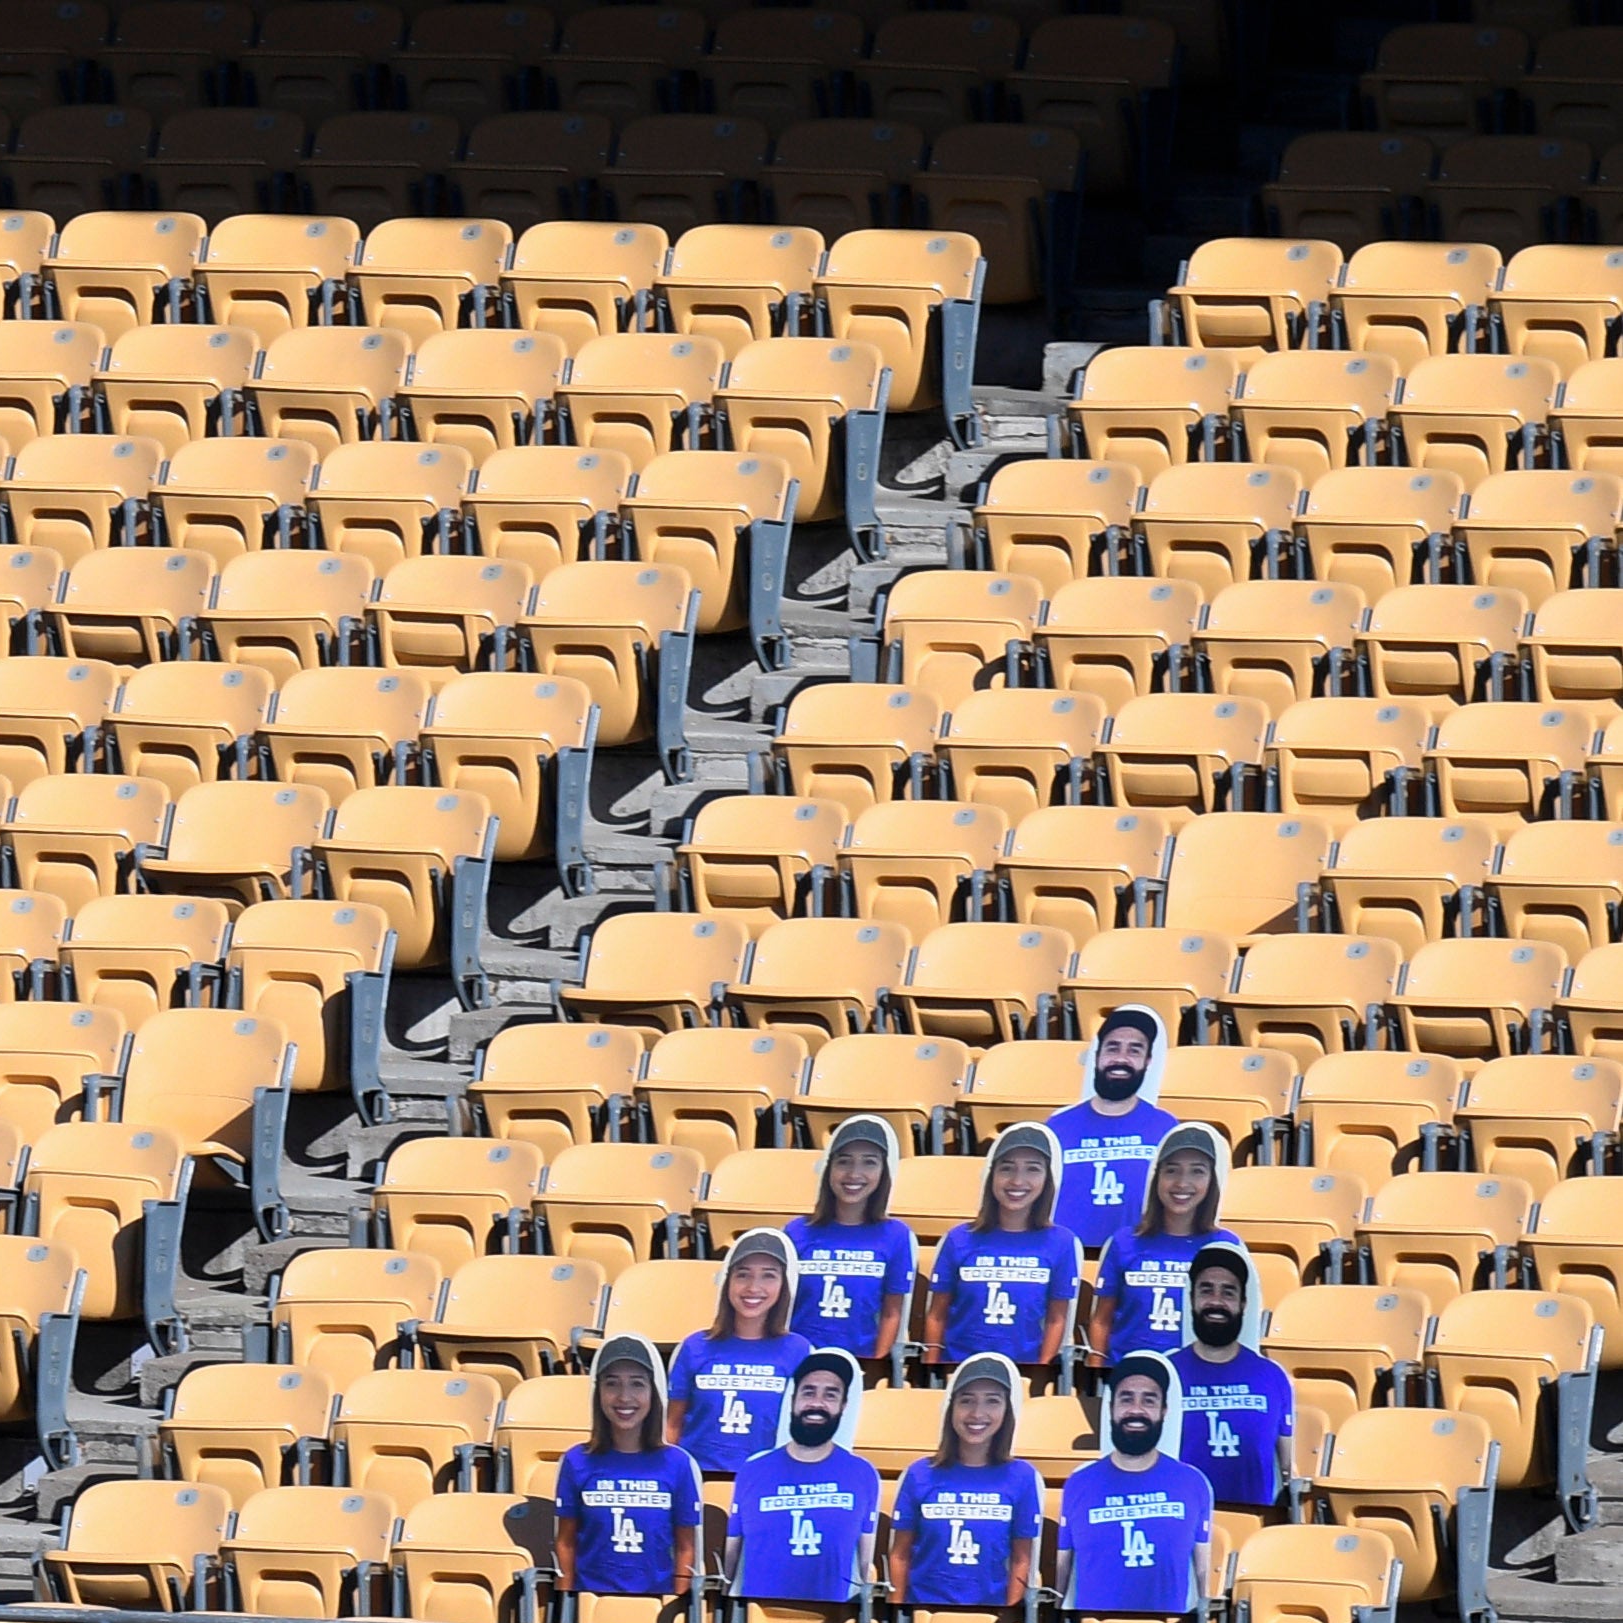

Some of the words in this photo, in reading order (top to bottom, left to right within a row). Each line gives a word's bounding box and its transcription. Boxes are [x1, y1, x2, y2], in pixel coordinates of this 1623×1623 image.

[1081, 1137, 1099, 1148] IN
[1102, 1135, 1142, 1147] THIS
[1066, 1147, 1154, 1160] TOGETHER
[1090, 1161, 1125, 1205] LA
[812, 1249, 831, 1260] IN
[834, 1249, 875, 1261] THIS
[976, 1255, 995, 1267] IN
[998, 1255, 1039, 1268] THIS
[1141, 1260, 1160, 1271] IN
[962, 1268, 1047, 1280] TOGETHER
[818, 1274, 852, 1318] LA
[983, 1281, 1017, 1325] LA
[1148, 1287, 1181, 1331] LA
[711, 1363, 731, 1374] IN
[734, 1363, 775, 1375] THIS
[697, 1376, 783, 1388] TOGETHER
[1190, 1386, 1208, 1396] IN
[1210, 1384, 1250, 1395] THIS
[718, 1390, 753, 1434] LA
[1206, 1411, 1240, 1457] LA
[597, 1479, 615, 1490] IN
[617, 1479, 658, 1491] THIS
[777, 1485, 796, 1495] IN
[798, 1483, 838, 1494] THIS
[584, 1492, 668, 1505] TOGETHER
[763, 1494, 850, 1508] TOGETHER
[938, 1492, 957, 1503] IN
[959, 1492, 1001, 1504] THIS
[1105, 1496, 1124, 1506] IN
[1126, 1492, 1167, 1504] THIS
[924, 1505, 1010, 1517] TOGETHER
[1092, 1504, 1181, 1520] TOGETHER
[611, 1507, 644, 1553] LA
[789, 1510, 822, 1556] LA
[947, 1519, 980, 1565] LA
[1121, 1521, 1155, 1567] LA
